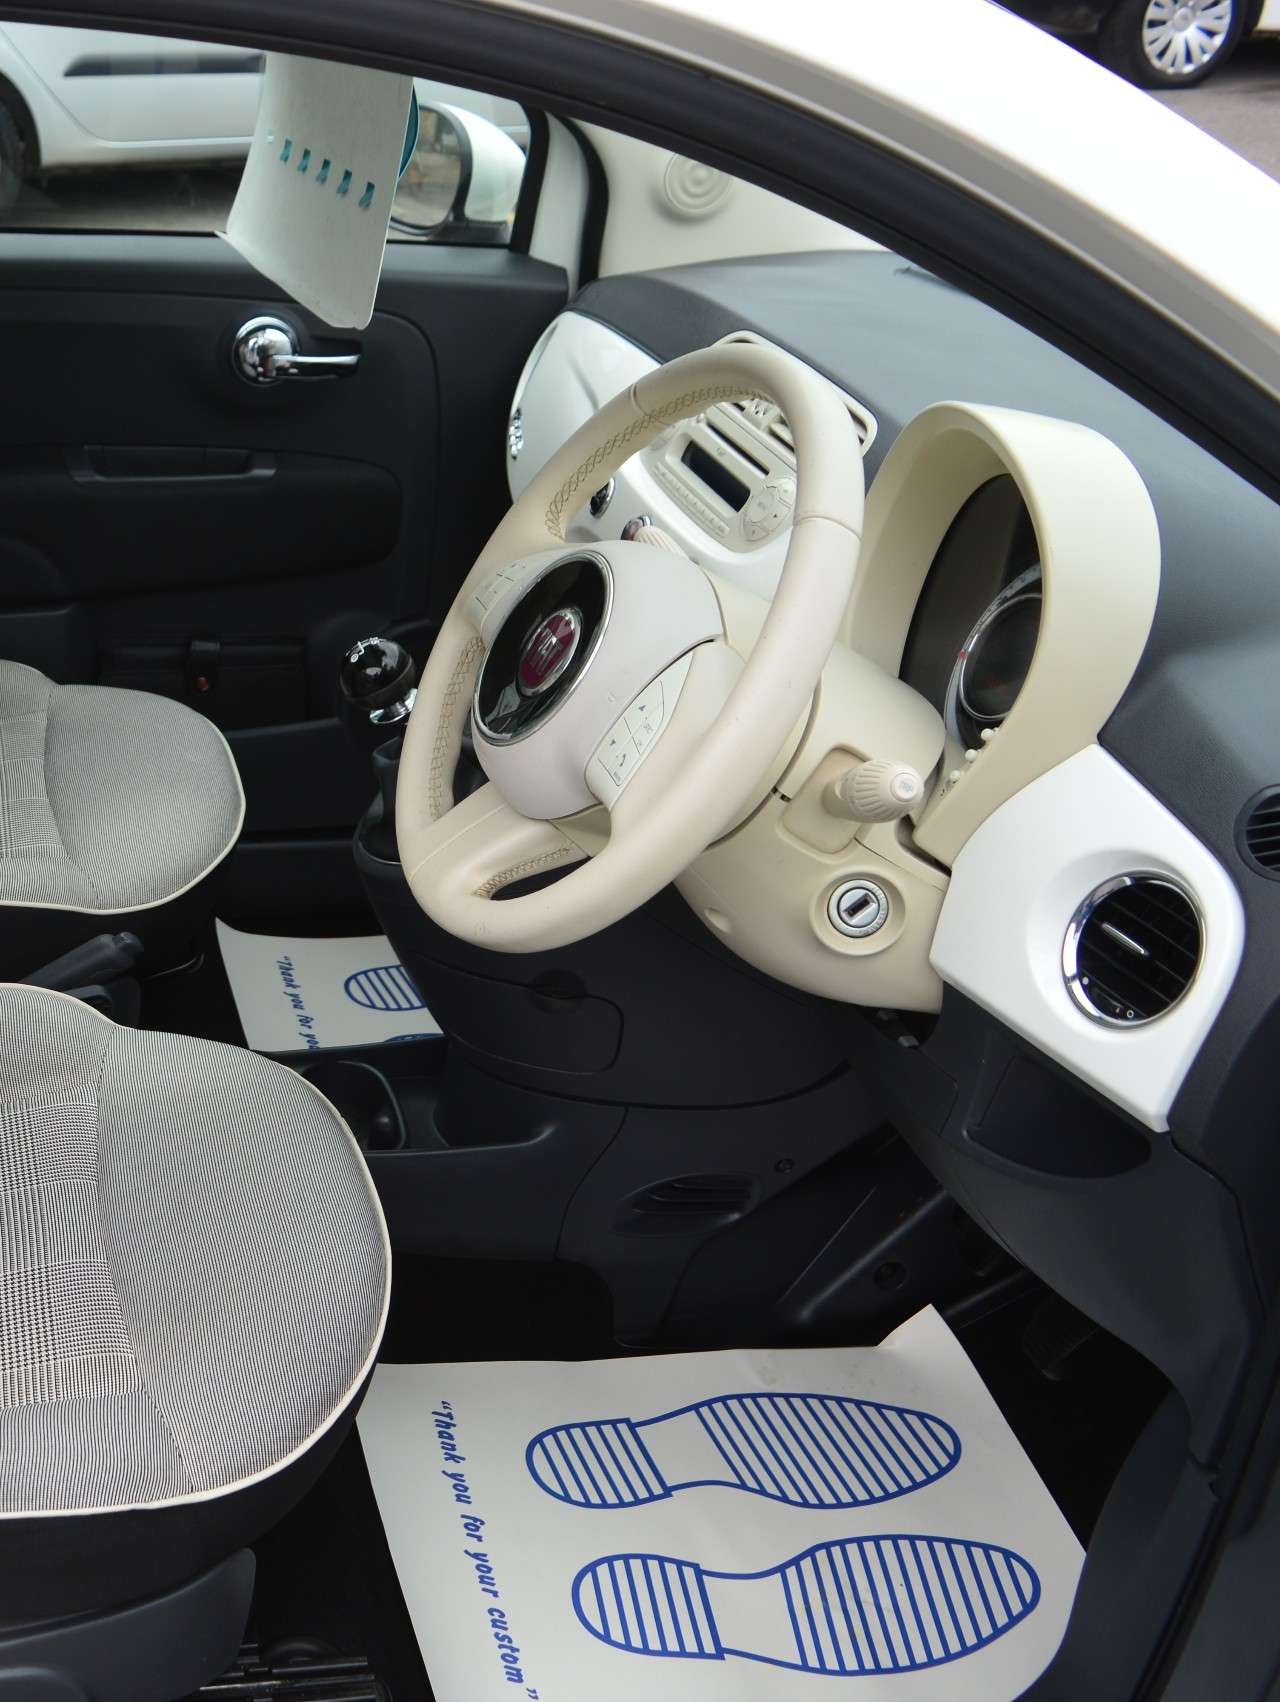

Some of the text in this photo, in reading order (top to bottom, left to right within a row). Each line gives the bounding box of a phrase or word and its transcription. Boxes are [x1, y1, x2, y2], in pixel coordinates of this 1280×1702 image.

[283, 991, 305, 1010] you
[296, 1014, 314, 1029] for
[441, 1469, 473, 1505] you
[460, 1513, 486, 1542] for
[463, 1549, 499, 1598] your
